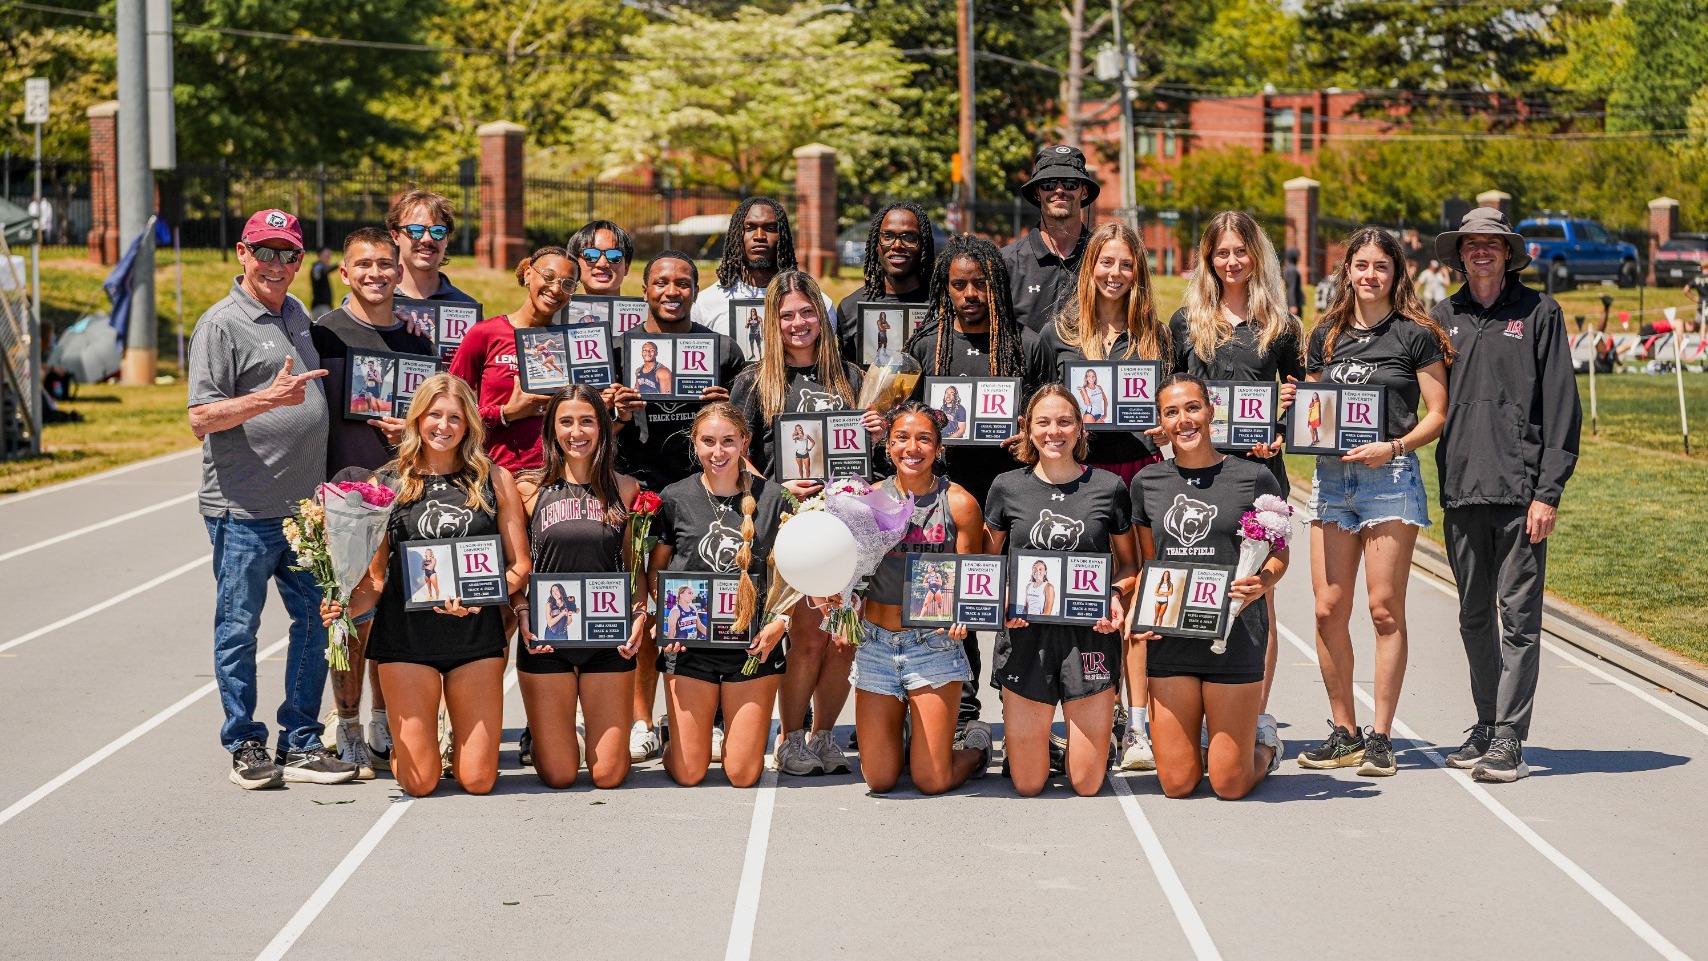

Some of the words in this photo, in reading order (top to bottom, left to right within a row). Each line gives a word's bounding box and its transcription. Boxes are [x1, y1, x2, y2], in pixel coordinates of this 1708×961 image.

[30, 101, 48, 117] 25
[444, 318, 468, 339] LR
[495, 354, 518, 364] LEN
[573, 339, 602, 361] LR
[681, 350, 708, 372] LR
[1122, 377, 1150, 399] LR
[980, 393, 1007, 416] LR
[1238, 398, 1265, 420] LR
[1345, 402, 1372, 425] LR
[648, 413, 671, 422] TRACK
[675, 411, 697, 420] FIELD
[833, 428, 861, 450] LR
[900, 543, 909, 552] &
[912, 543, 945, 553] FIELD
[1166, 547, 1188, 556] TRACK
[1193, 547, 1215, 556] FIELD
[463, 552, 494, 574] LR
[964, 573, 994, 597] LR
[1072, 569, 1100, 593] LR
[590, 591, 620, 614] LR
[1191, 581, 1217, 605] LR
[1080, 651, 1110, 674] LR
